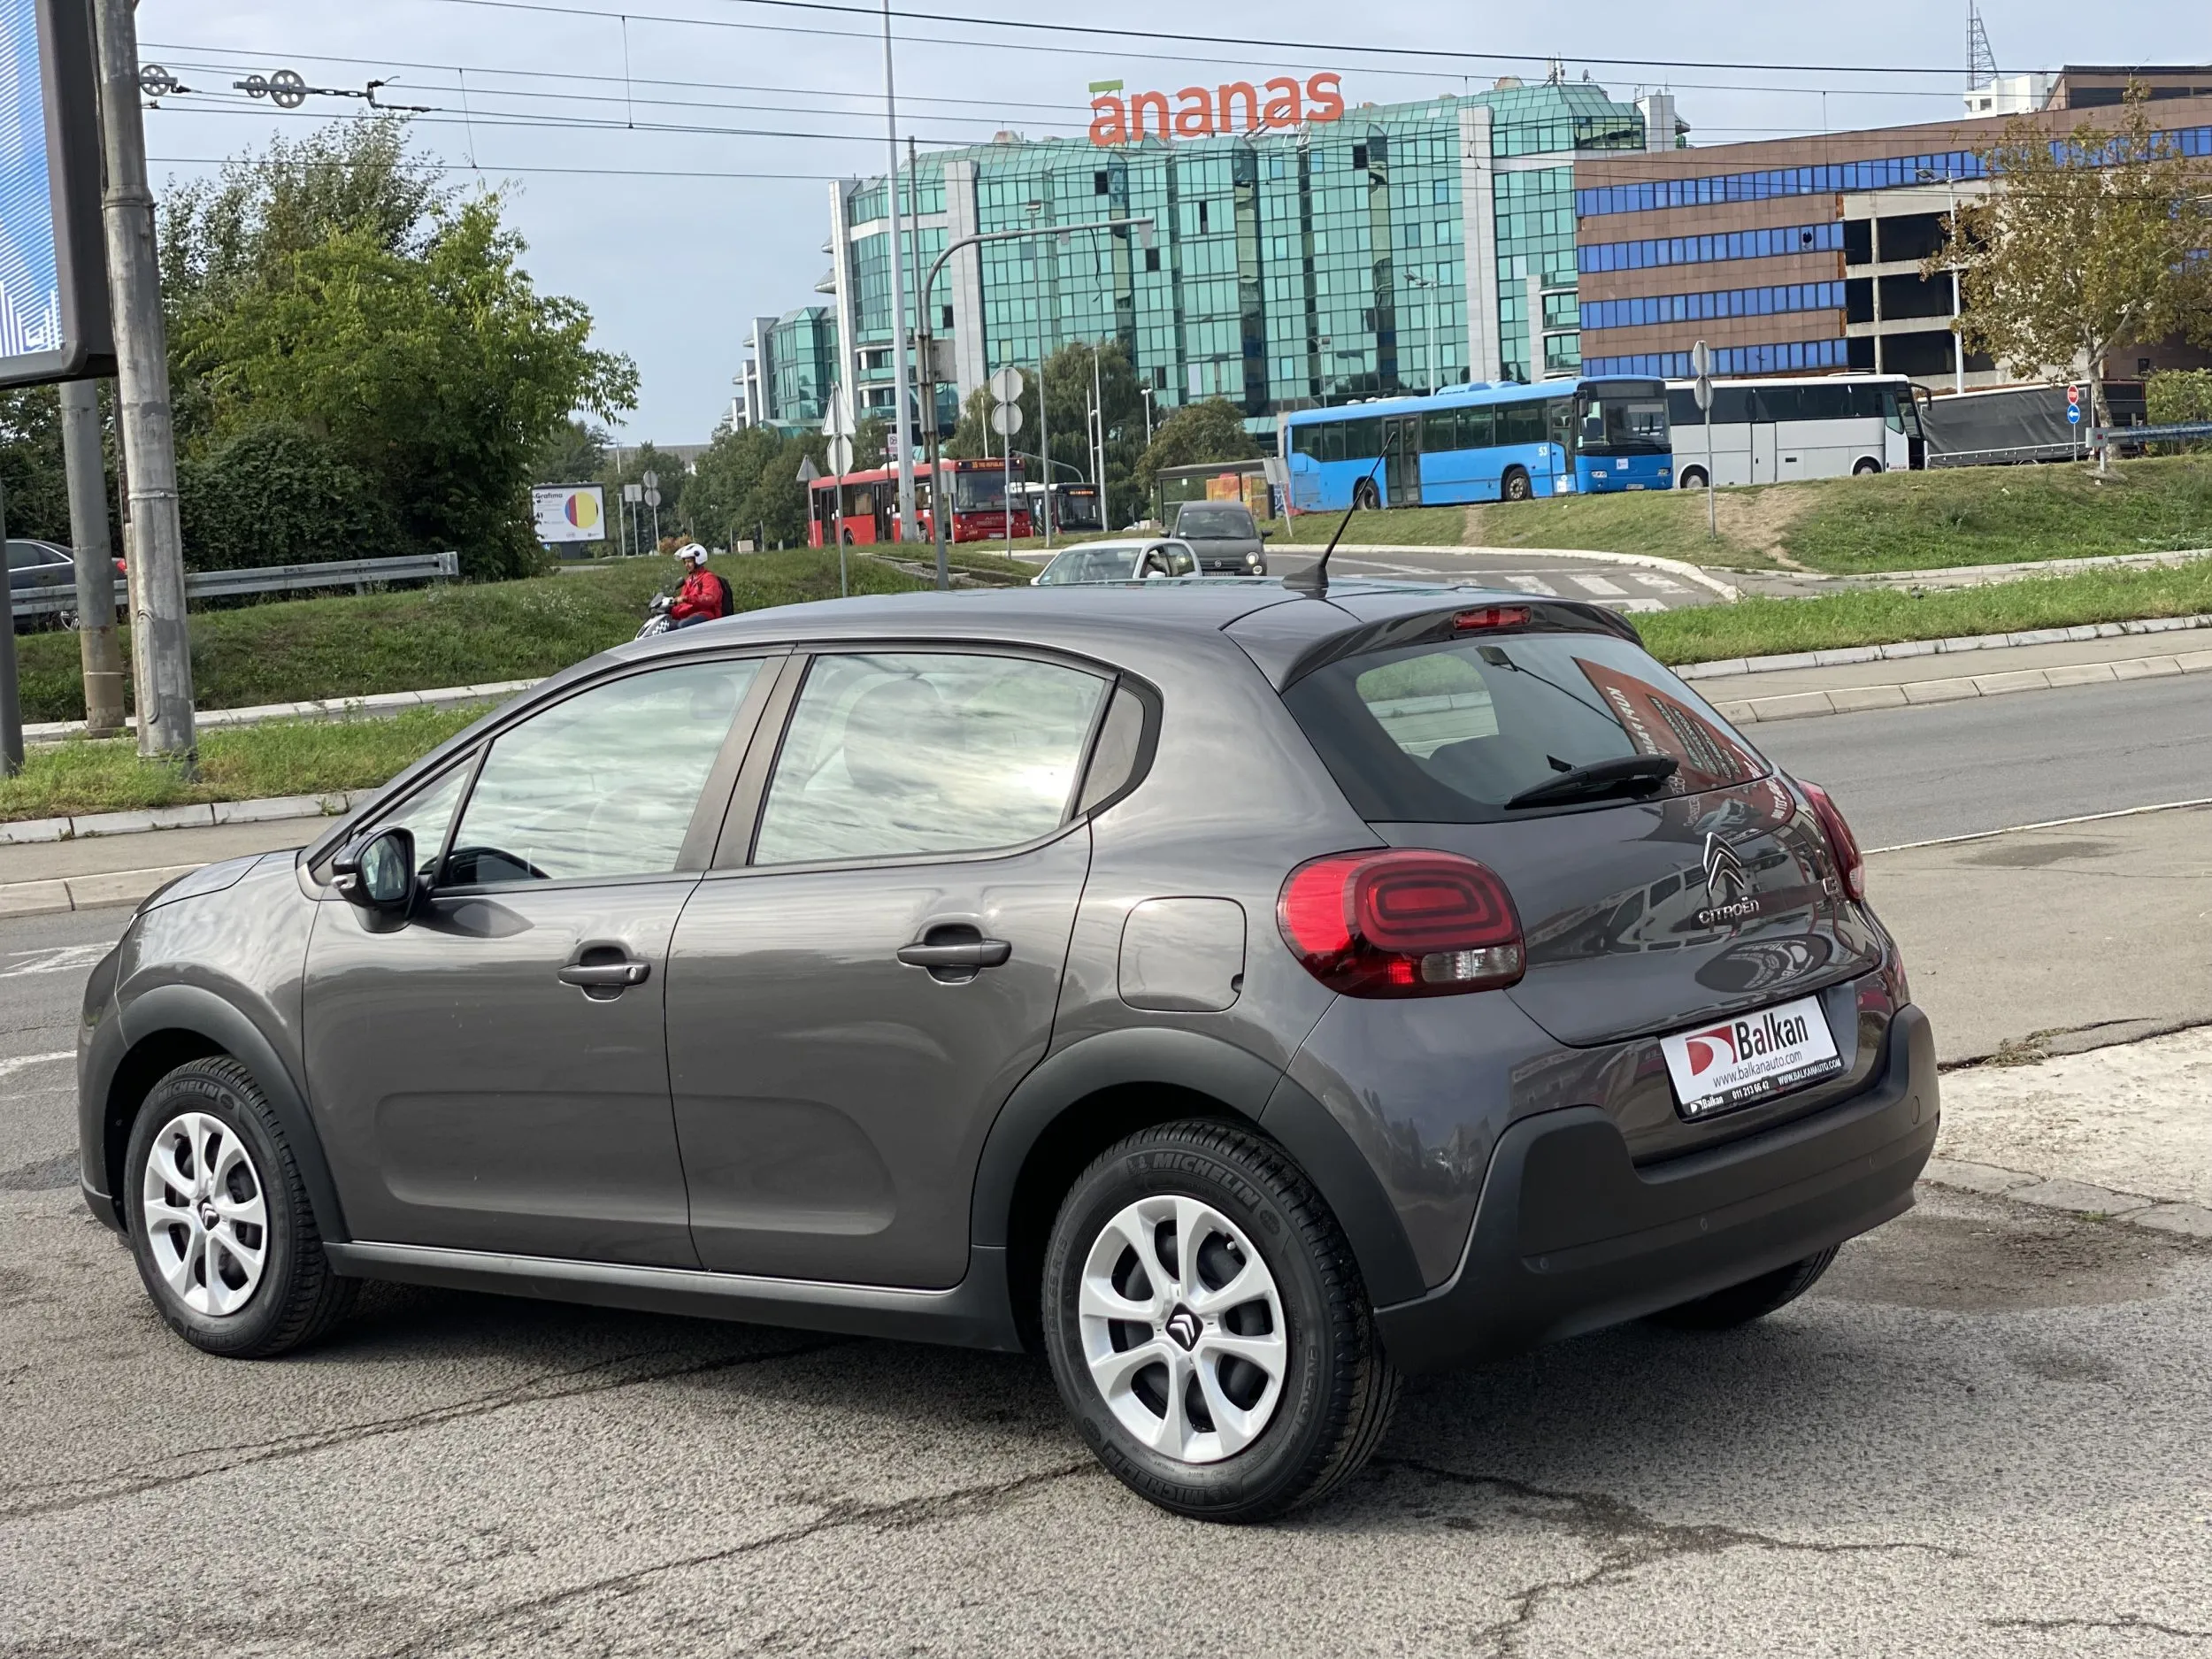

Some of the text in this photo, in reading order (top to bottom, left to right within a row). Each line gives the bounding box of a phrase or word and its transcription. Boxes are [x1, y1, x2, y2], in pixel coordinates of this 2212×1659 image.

[1735, 1012, 1809, 1061] Balkan
[1701, 1095, 1724, 1110] Balkan
[1732, 1089, 1743, 1100] 011
[1743, 1086, 1754, 1097] 213
[1762, 1080, 1770, 1091] 42
[1778, 1058, 1842, 1086] WWW.BALKANAUTO.COM
[1713, 1049, 1803, 1088] www.balkanauto.com
[1153, 1153, 1260, 1208] MICHELIN
